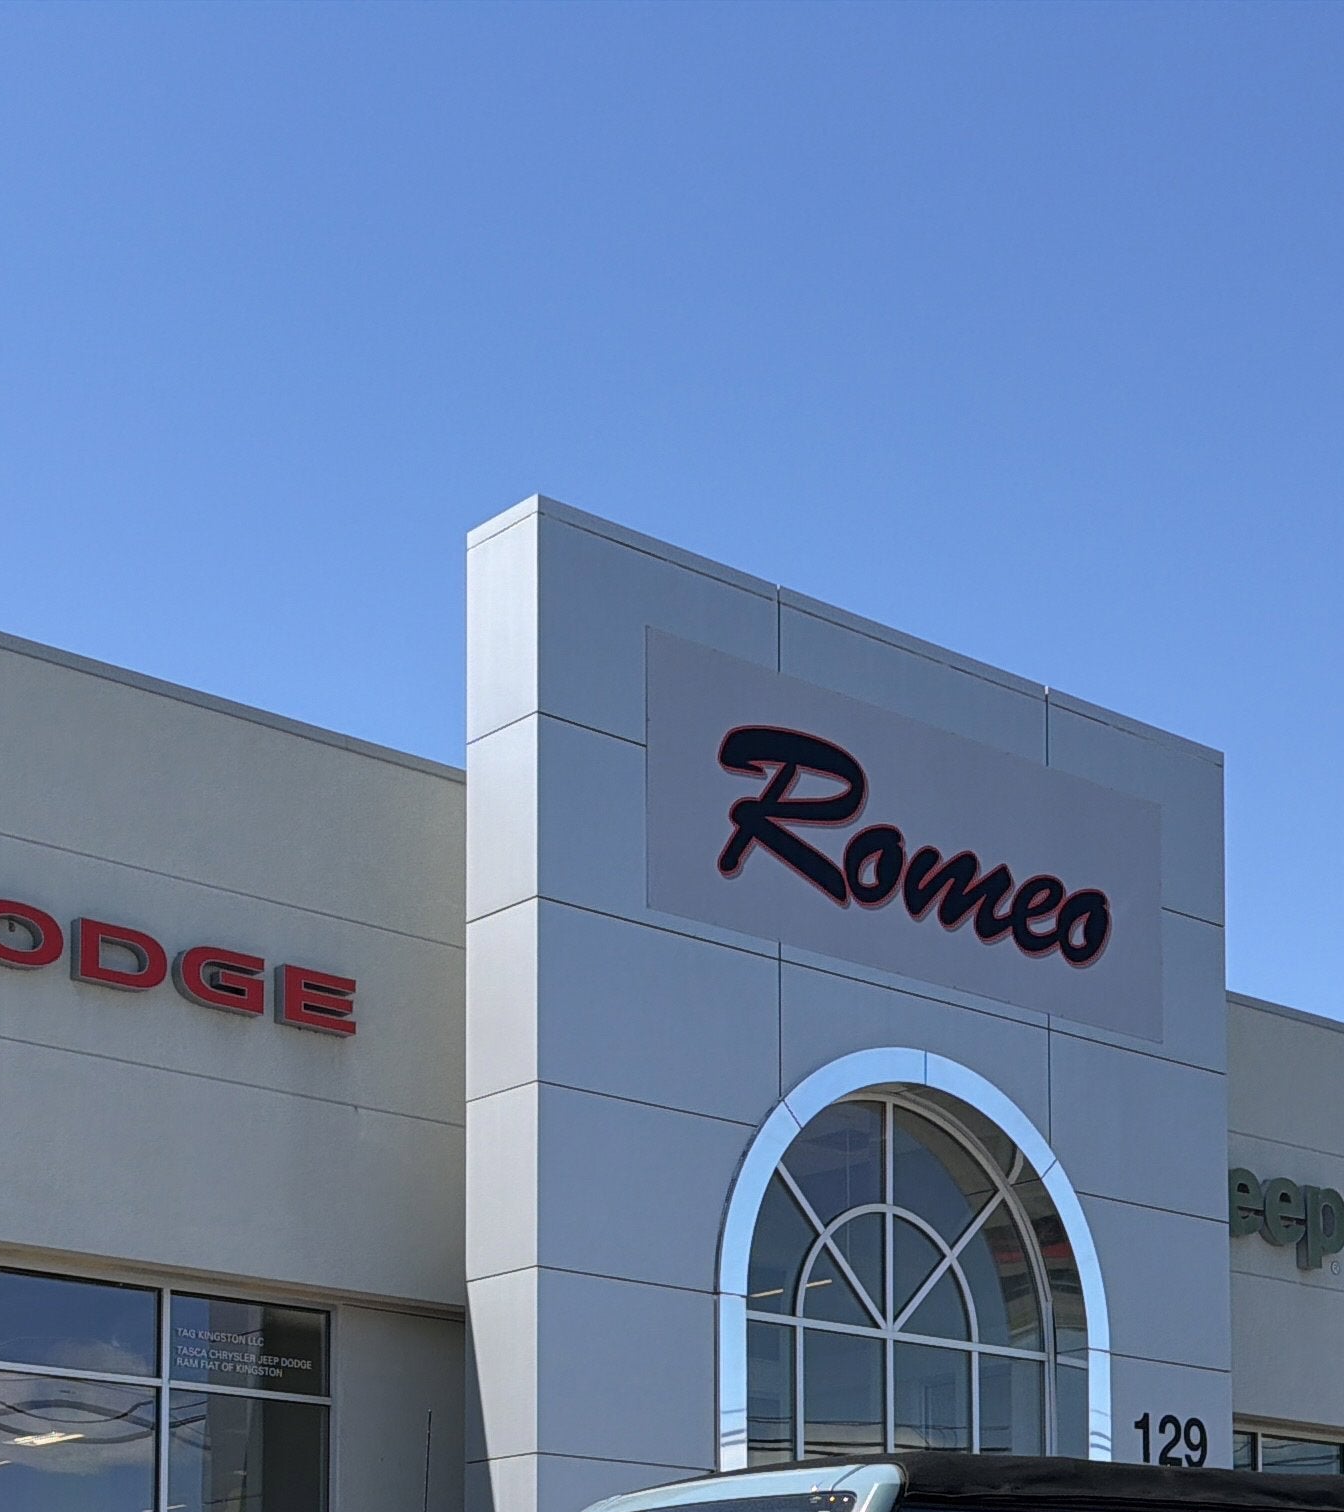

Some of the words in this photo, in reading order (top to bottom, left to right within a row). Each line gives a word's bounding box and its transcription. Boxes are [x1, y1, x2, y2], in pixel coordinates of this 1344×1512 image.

[717, 725, 1112, 969] Romeo
[176, 1327, 196, 1338] TAG
[197, 1330, 246, 1345] KINGSTON
[248, 1336, 265, 1347] LLC
[176, 1345, 208, 1357] TASCA
[208, 1349, 256, 1363] CHRYSLER
[258, 1355, 279, 1366] JEEP
[280, 1357, 312, 1370] DODGE
[176, 1357, 199, 1368] RAM
[200, 1359, 221, 1371] FIAT
[221, 1362, 235, 1373] OF
[235, 1363, 283, 1378] KINGSTON
[1134, 1412, 1208, 1468] 129
